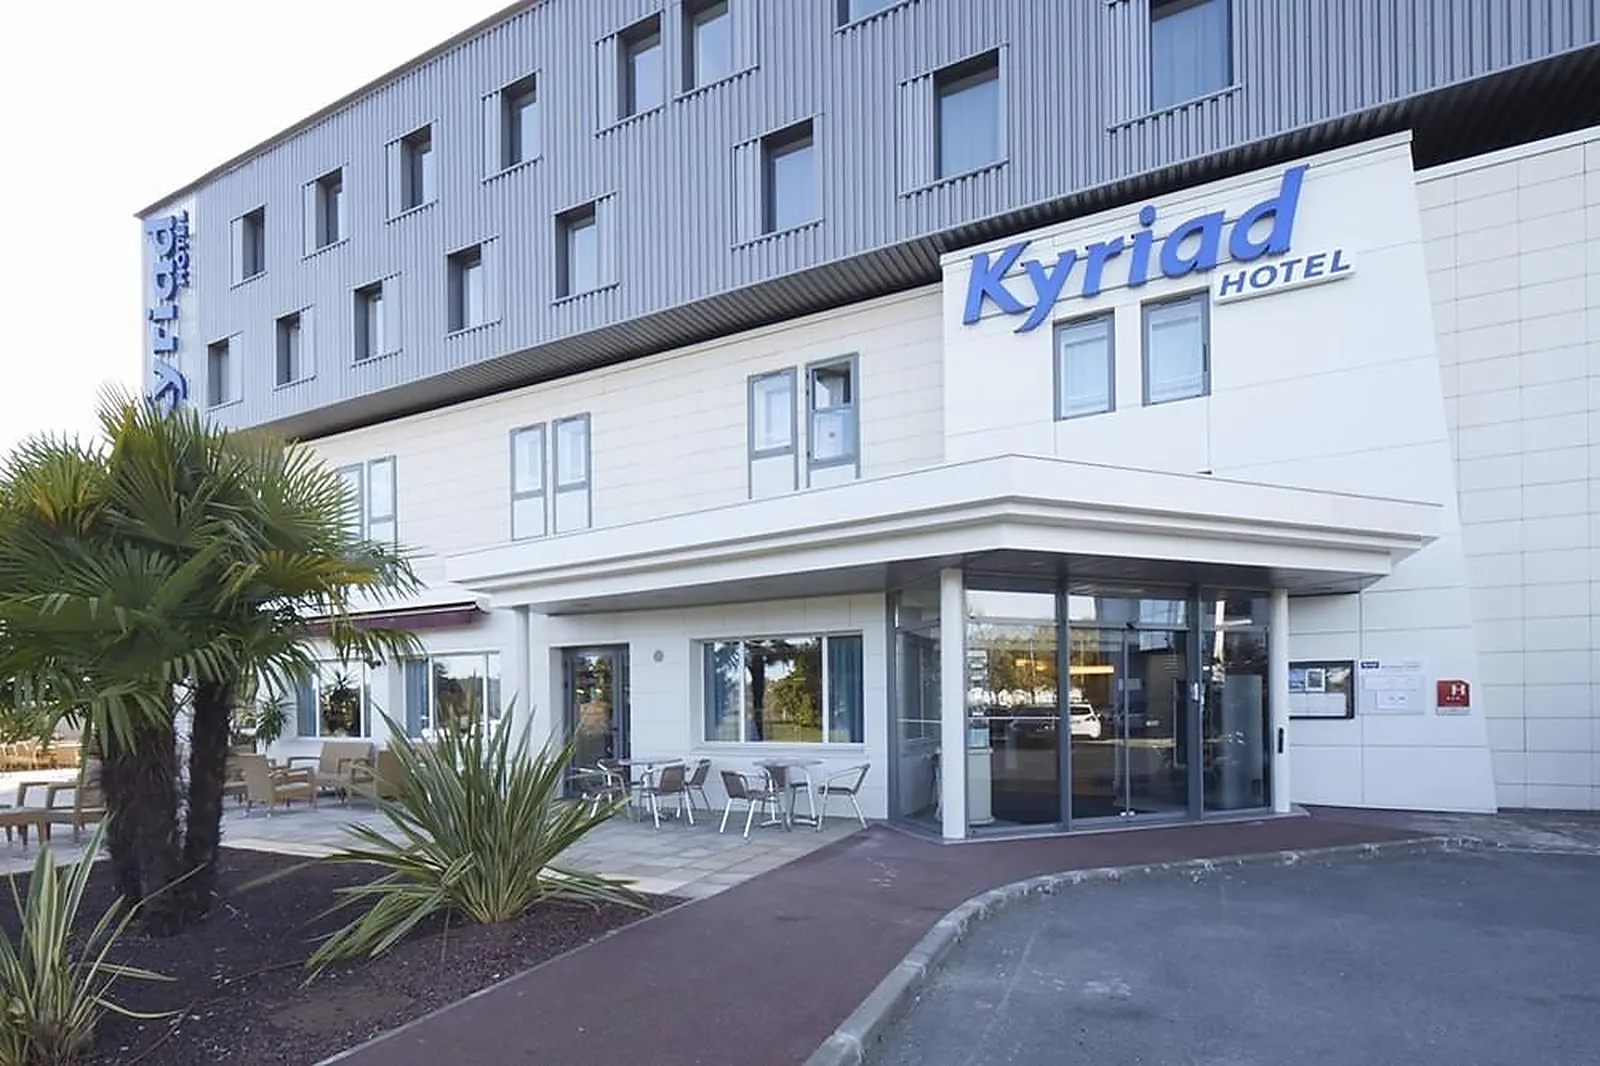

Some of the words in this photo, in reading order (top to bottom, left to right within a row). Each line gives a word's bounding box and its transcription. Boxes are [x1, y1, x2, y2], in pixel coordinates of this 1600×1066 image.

[175, 209, 190, 288] HOTEL
[963, 164, 1309, 333] Kyriad
[1219, 249, 1351, 297] HOTEL
[144, 215, 187, 419] yriad
